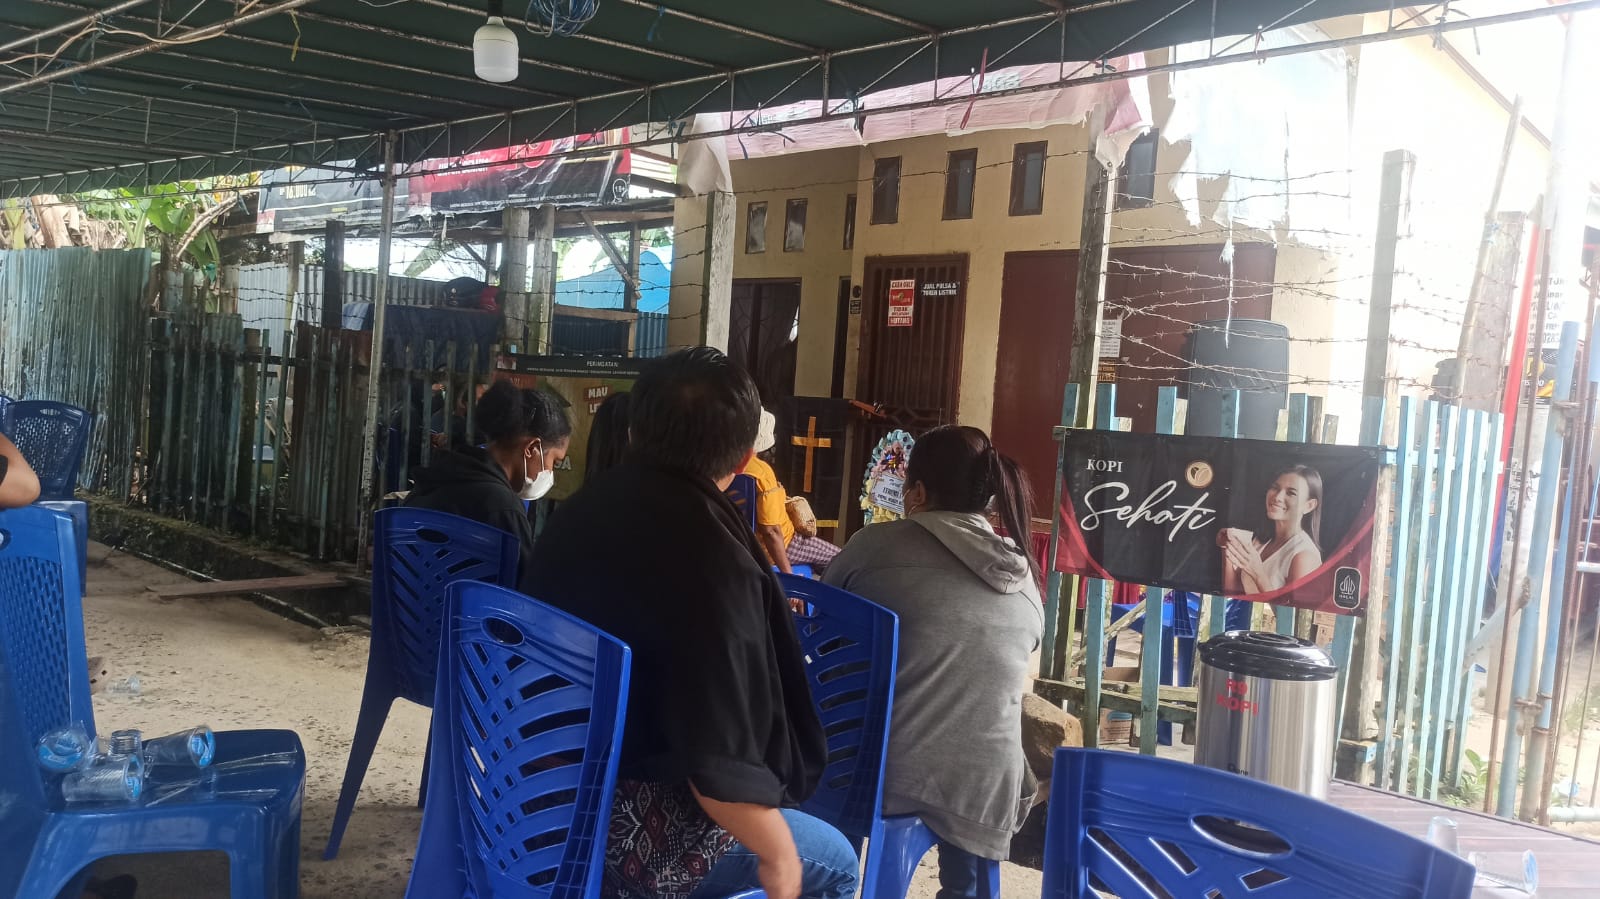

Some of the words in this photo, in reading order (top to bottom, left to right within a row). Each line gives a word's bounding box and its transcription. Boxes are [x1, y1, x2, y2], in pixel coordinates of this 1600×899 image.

[588, 387, 608, 399] MAU
[1086, 457, 1123, 473] KOPI
[1080, 479, 1217, 543] Sehati
[1225, 678, 1248, 696] R9
[1216, 693, 1259, 716] KOPI
